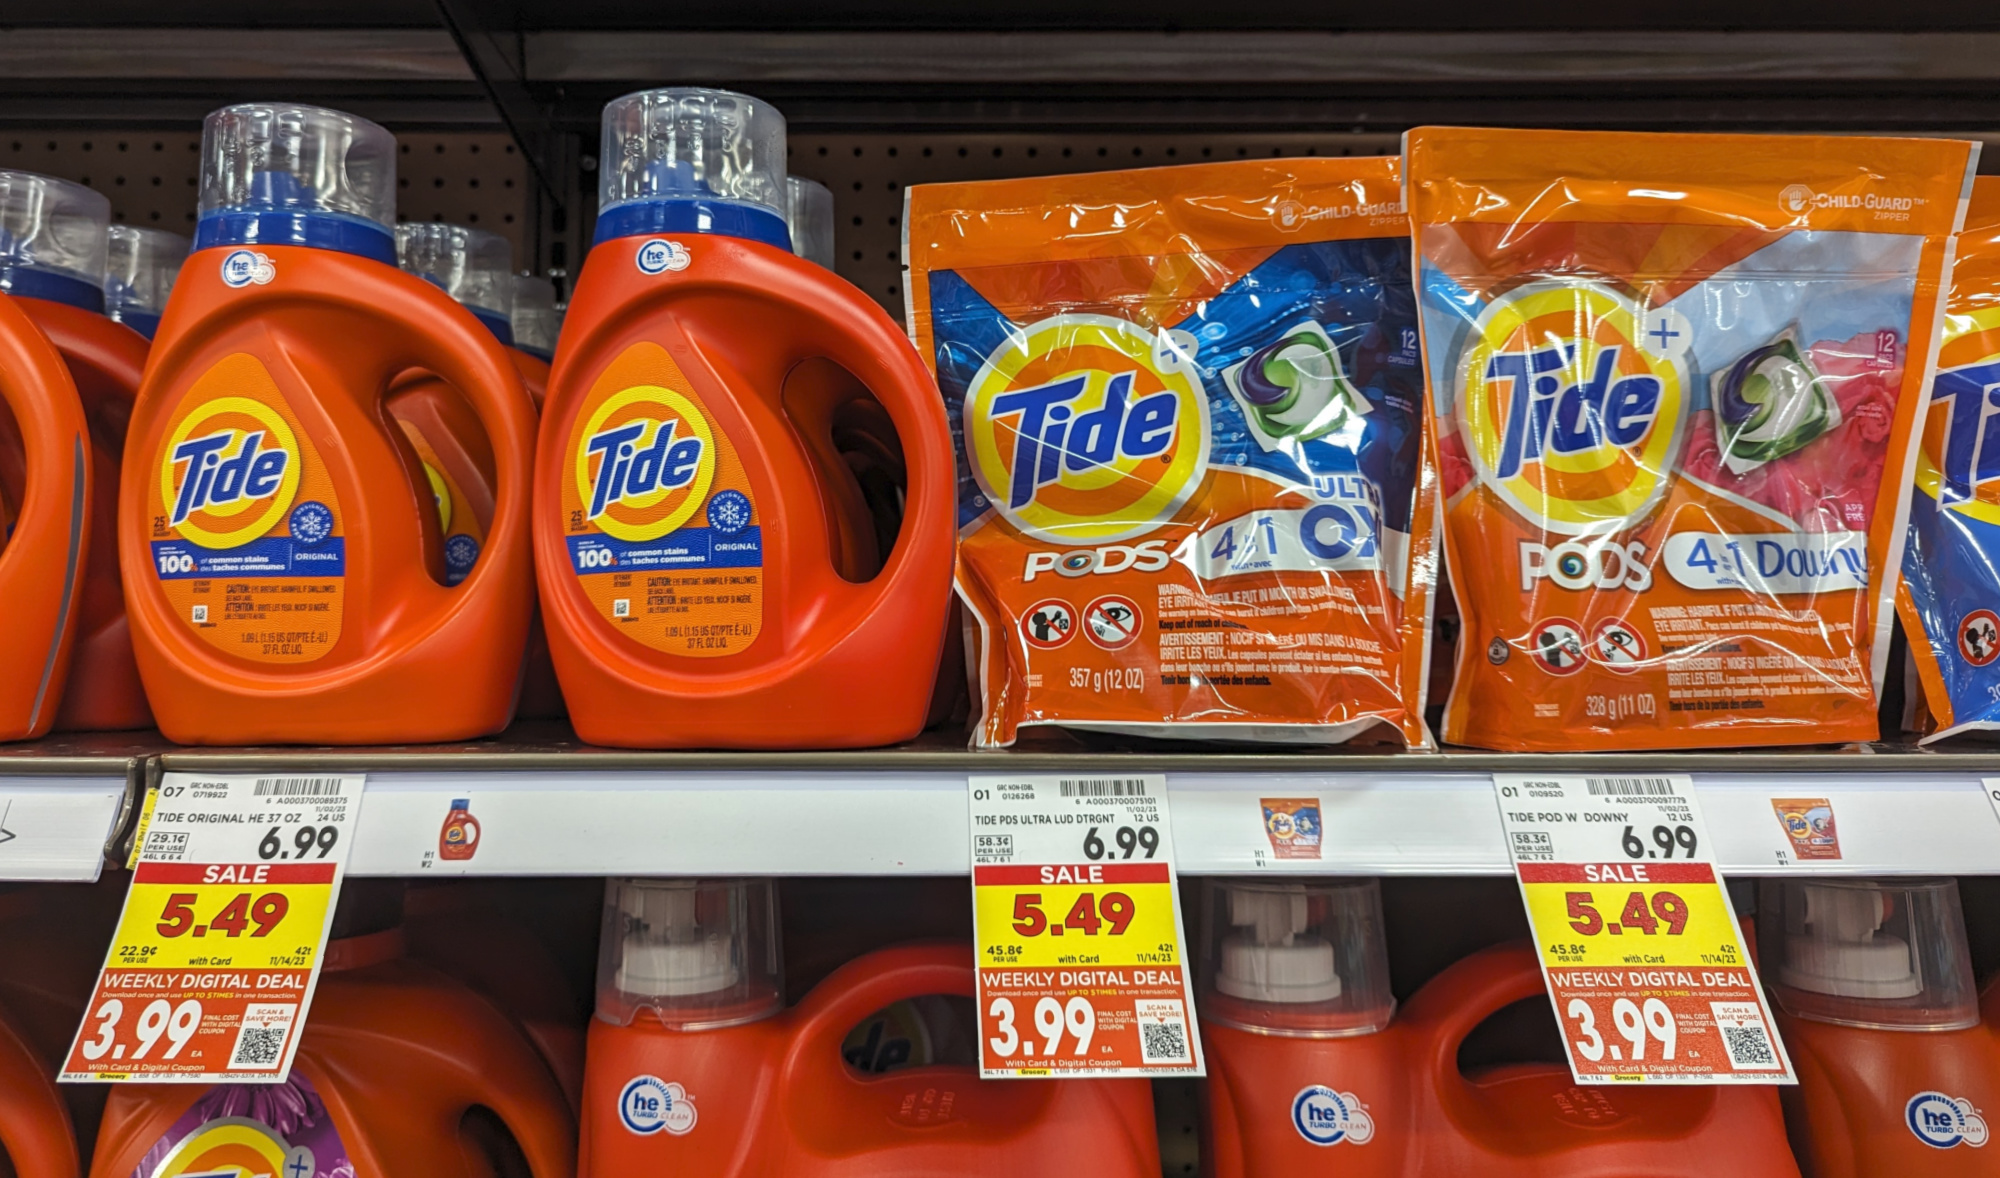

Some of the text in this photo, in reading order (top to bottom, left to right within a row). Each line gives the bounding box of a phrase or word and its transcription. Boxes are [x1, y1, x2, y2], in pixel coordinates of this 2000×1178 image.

[1369, 217, 1406, 226] ZIPPER
[1874, 212, 1910, 221] ZIPPER
[647, 250, 664, 260] he
[232, 260, 248, 271] he
[1402, 330, 1416, 349] 12
[1878, 333, 1895, 352] 12
[1484, 341, 1663, 480] Tide
[987, 369, 1180, 514] Tide
[585, 418, 705, 521] Tide
[168, 430, 289, 528] Tide
[154, 516, 166, 527] 25
[571, 510, 582, 522] 25
[715, 543, 758, 551] ORIGINAL
[1211, 526, 1238, 560] 4
[295, 553, 339, 561] ORIGINAL
[628, 549, 663, 557] common
[664, 548, 689, 556] stains
[159, 555, 199, 574] 100%
[244, 555, 269, 563] stains
[577, 549, 618, 569] 100%
[660, 555, 705, 563] communes
[1024, 543, 1173, 582] PODS
[1686, 538, 1868, 586] 4 Downy
[1520, 539, 1653, 593] PODS
[1070, 667, 1144, 693] 357 g (12 OZ)
[1586, 696, 1606, 716] 328
[1609, 700, 1615, 719] g
[1618, 695, 1634, 719] (11
[1638, 694, 1656, 719] OZ)
[163, 787, 185, 797] 07
[974, 790, 990, 800] 01
[1501, 787, 1519, 797] 01
[157, 813, 302, 823] TIDE ORIGINAL HE 37 OZ
[317, 814, 345, 822] 24 US
[975, 814, 1115, 825] TIDE PDS ULTRA LUD DTRGNT
[1134, 814, 1159, 822] 12 US
[1507, 813, 1629, 822] TIDE POD W DOWNY
[151, 834, 185, 843] 29.1¢
[258, 825, 339, 860] 6.99
[978, 837, 1009, 846] 58.3¢
[1083, 825, 1159, 860] 6.99
[1516, 835, 1547, 844] 58.3¢
[1621, 825, 1697, 859] 6.99
[202, 865, 271, 883] SALE
[1040, 866, 1104, 884] SALE
[1584, 864, 1650, 883] SALE
[156, 892, 289, 938] 5.49
[1012, 891, 1135, 937] 5.49
[1565, 891, 1689, 936] 5.49
[119, 946, 158, 956] 22.9¢
[295, 947, 311, 955] 42t
[986, 945, 1023, 955] 45.8¢
[1158, 944, 1173, 952] 42t
[1550, 945, 1586, 954] 45.8¢
[1720, 945, 1736, 953] 42t
[189, 957, 232, 965] with Card
[269, 957, 305, 966] 11/14/23
[1058, 954, 1100, 963] with Card
[1137, 953, 1172, 963] 11/14/23
[1623, 954, 1665, 963] with Card
[1701, 954, 1736, 963] 11/14/23
[103, 973, 305, 989] WEEKLY DIGITAL DEAL
[982, 970, 1180, 987] WEEKLY DIGITAL DEAL
[1551, 972, 1750, 988] WEEKLY DIGITAL DEAL
[82, 999, 203, 1061] 3.99
[989, 996, 1096, 1057] 3.99
[1567, 998, 1677, 1061] 3.99
[141, 1063, 169, 1073] Digital
[171, 1064, 205, 1073] Coupon
[1005, 1059, 1122, 1068] With Card & Digital Coupon
[1596, 1064, 1712, 1074] With Card & Digital Coupon
[634, 1092, 659, 1111] he
[661, 1112, 689, 1120] CLEAN
[1308, 1103, 1335, 1121] he
[1922, 1108, 1952, 1126] he
